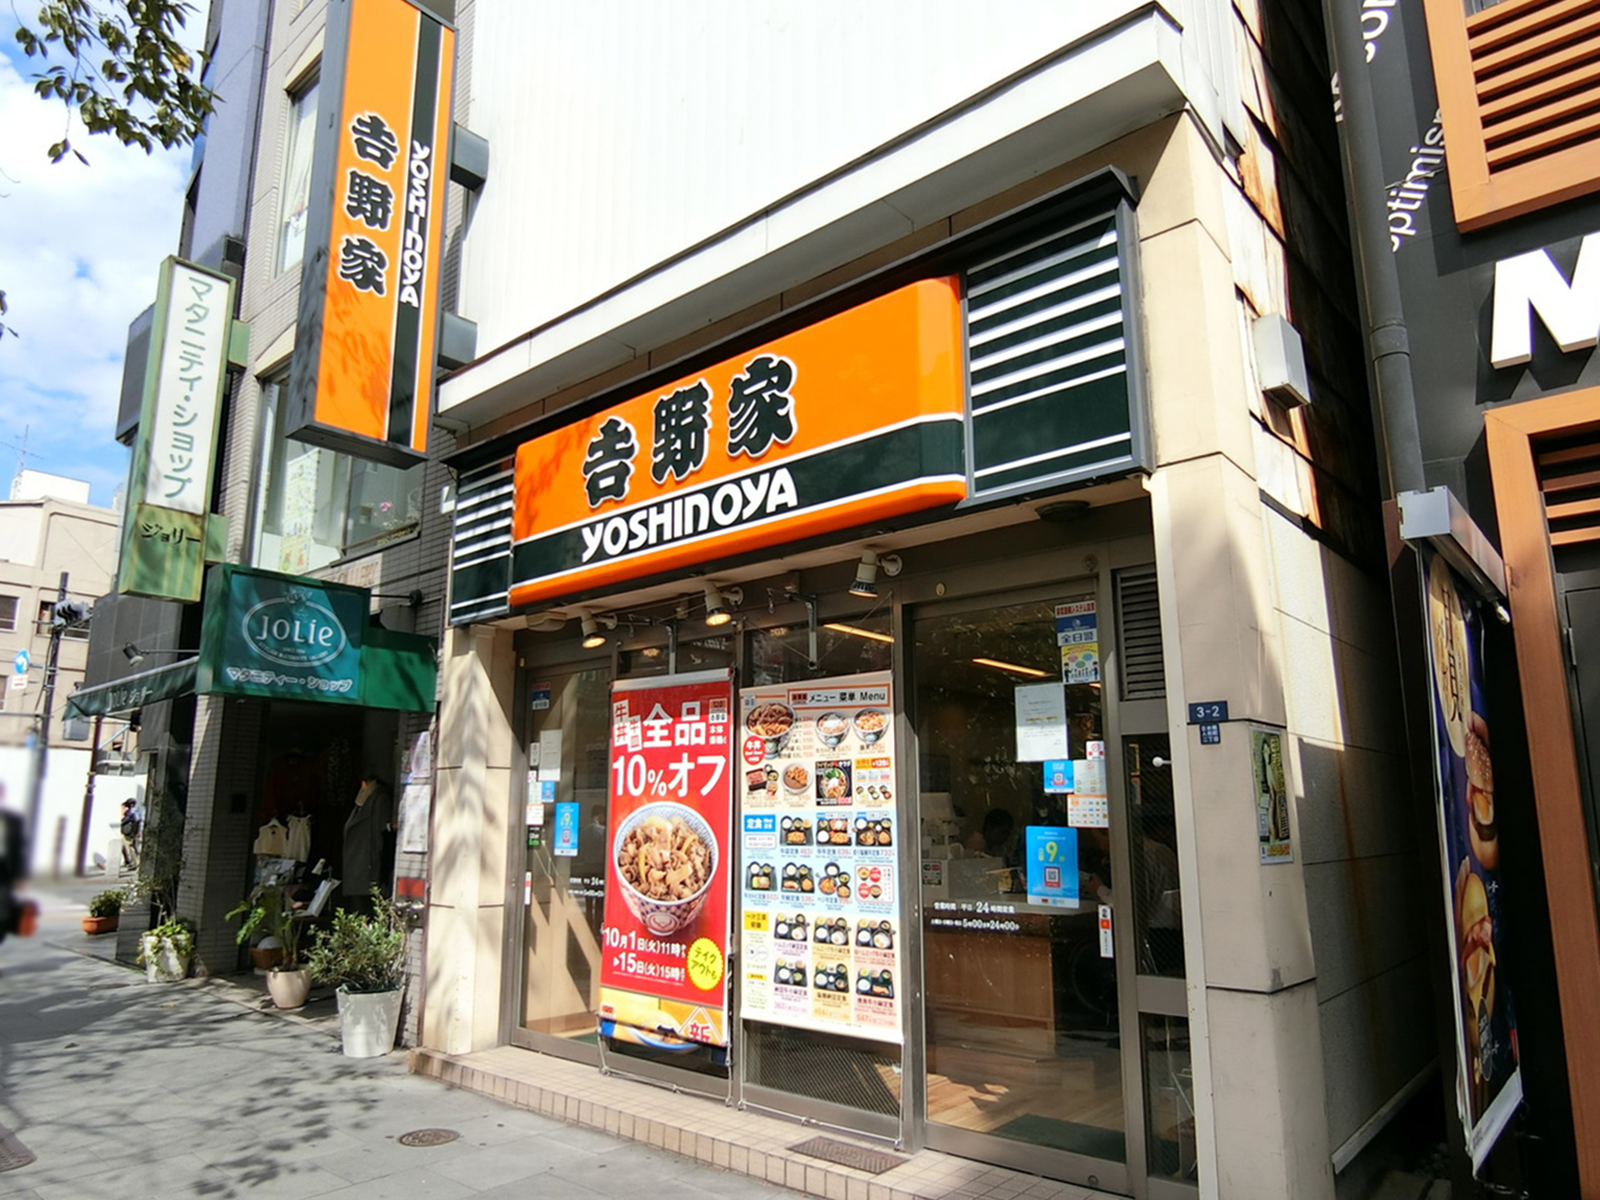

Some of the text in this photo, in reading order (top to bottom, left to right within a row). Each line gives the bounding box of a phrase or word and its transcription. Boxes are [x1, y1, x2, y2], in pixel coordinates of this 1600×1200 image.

[340, 110, 400, 297] 吉野家
[400, 140, 431, 308] YOSHINOYA
[582, 353, 797, 509] 吉野家
[142, 520, 201, 546] ジョリー
[581, 467, 799, 563] YOSHINOYA
[226, 667, 352, 692] マタニティー・ショップ
[809, 693, 836, 703] メニュー
[860, 691, 885, 701] Menu
[642, 702, 706, 748] 全品
[1196, 705, 1220, 718] 3-2
[612, 753, 727, 797] 10%オフ
